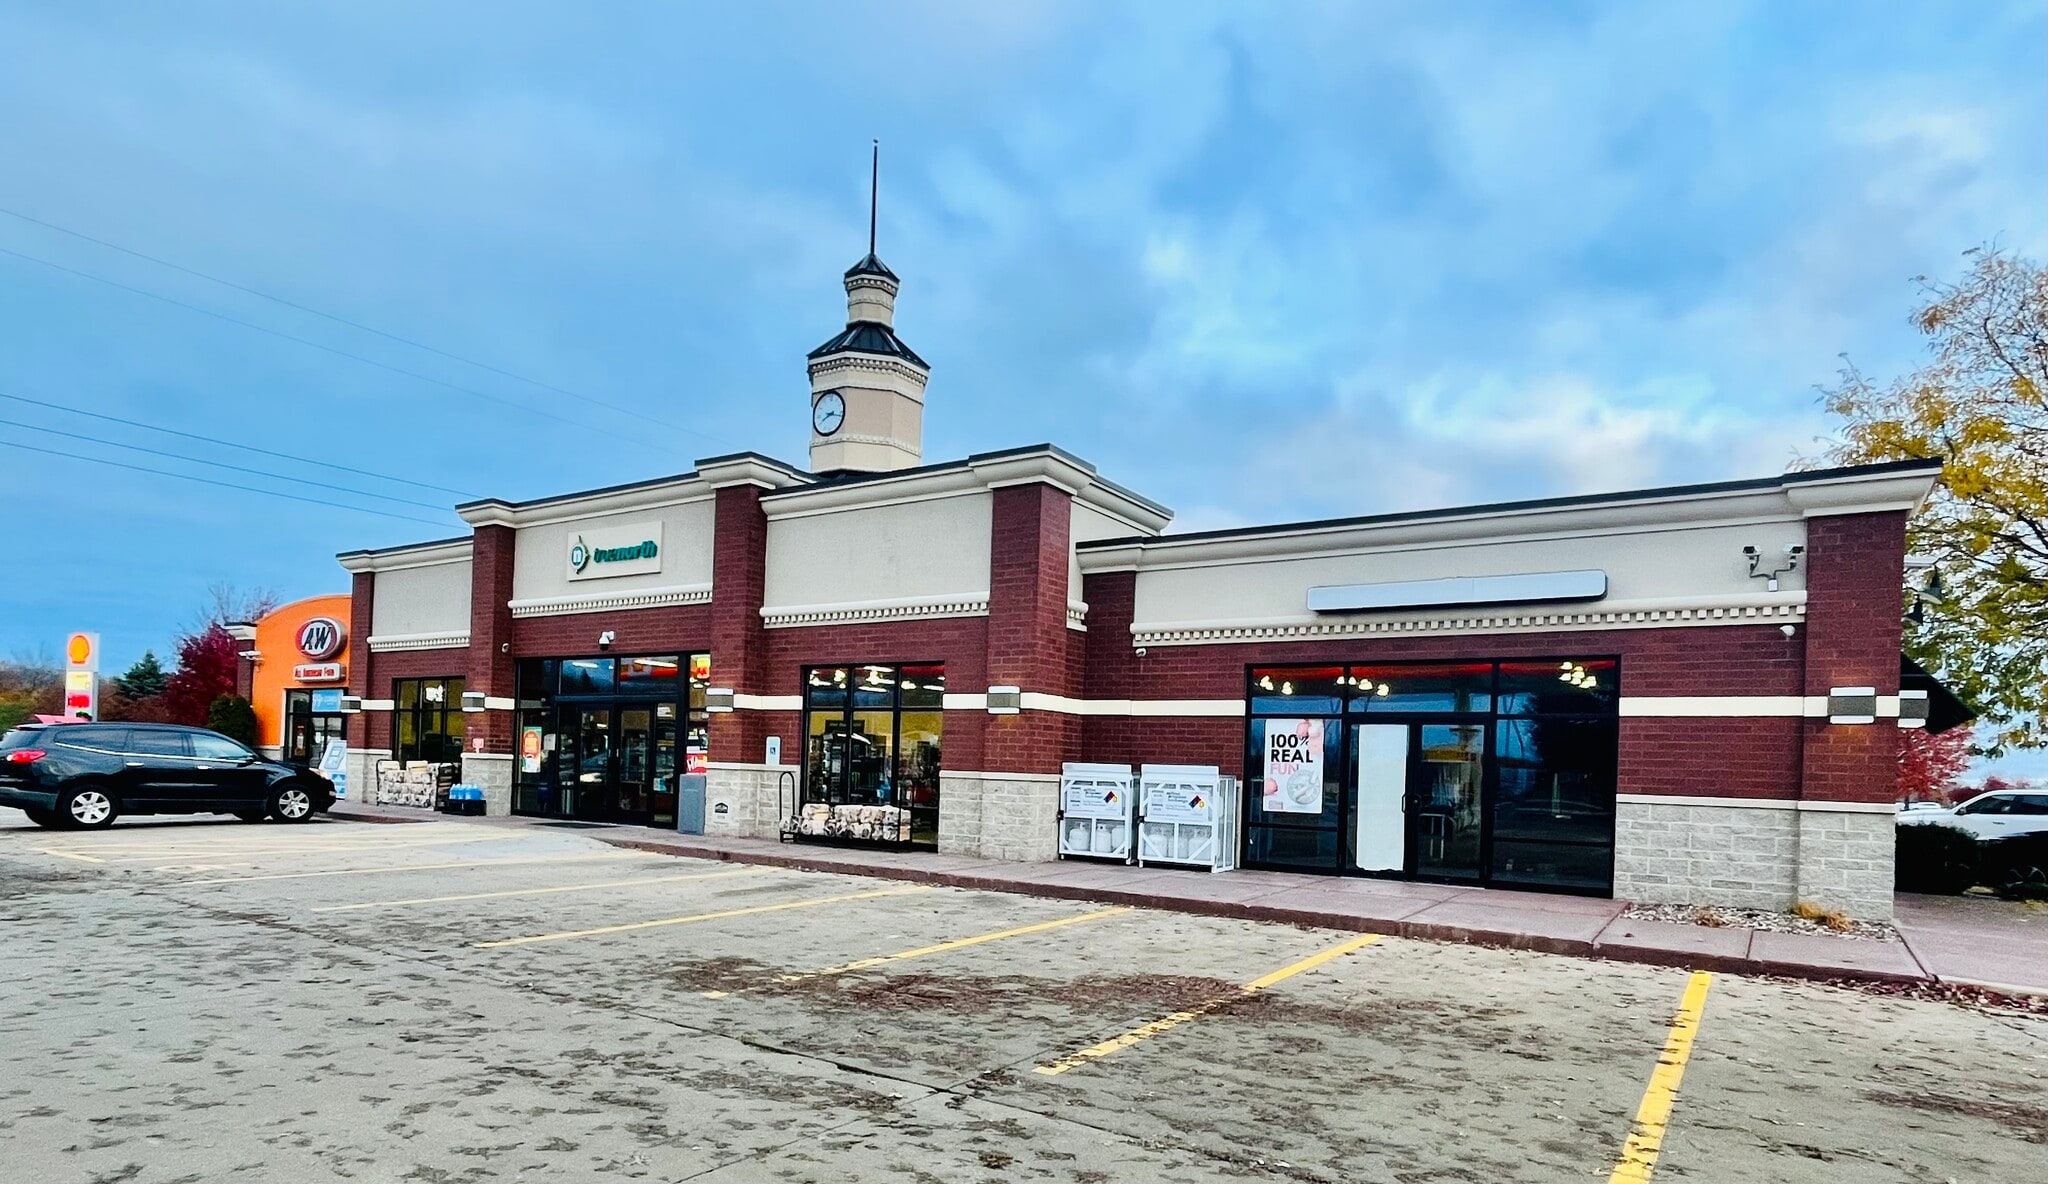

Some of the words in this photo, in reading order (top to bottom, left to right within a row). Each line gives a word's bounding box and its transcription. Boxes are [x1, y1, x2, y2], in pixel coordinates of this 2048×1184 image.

[301, 626, 333, 651] AW
[1270, 733, 1310, 748] 100%
[1270, 748, 1314, 763] REAL
[1269, 762, 1299, 775] FUN
